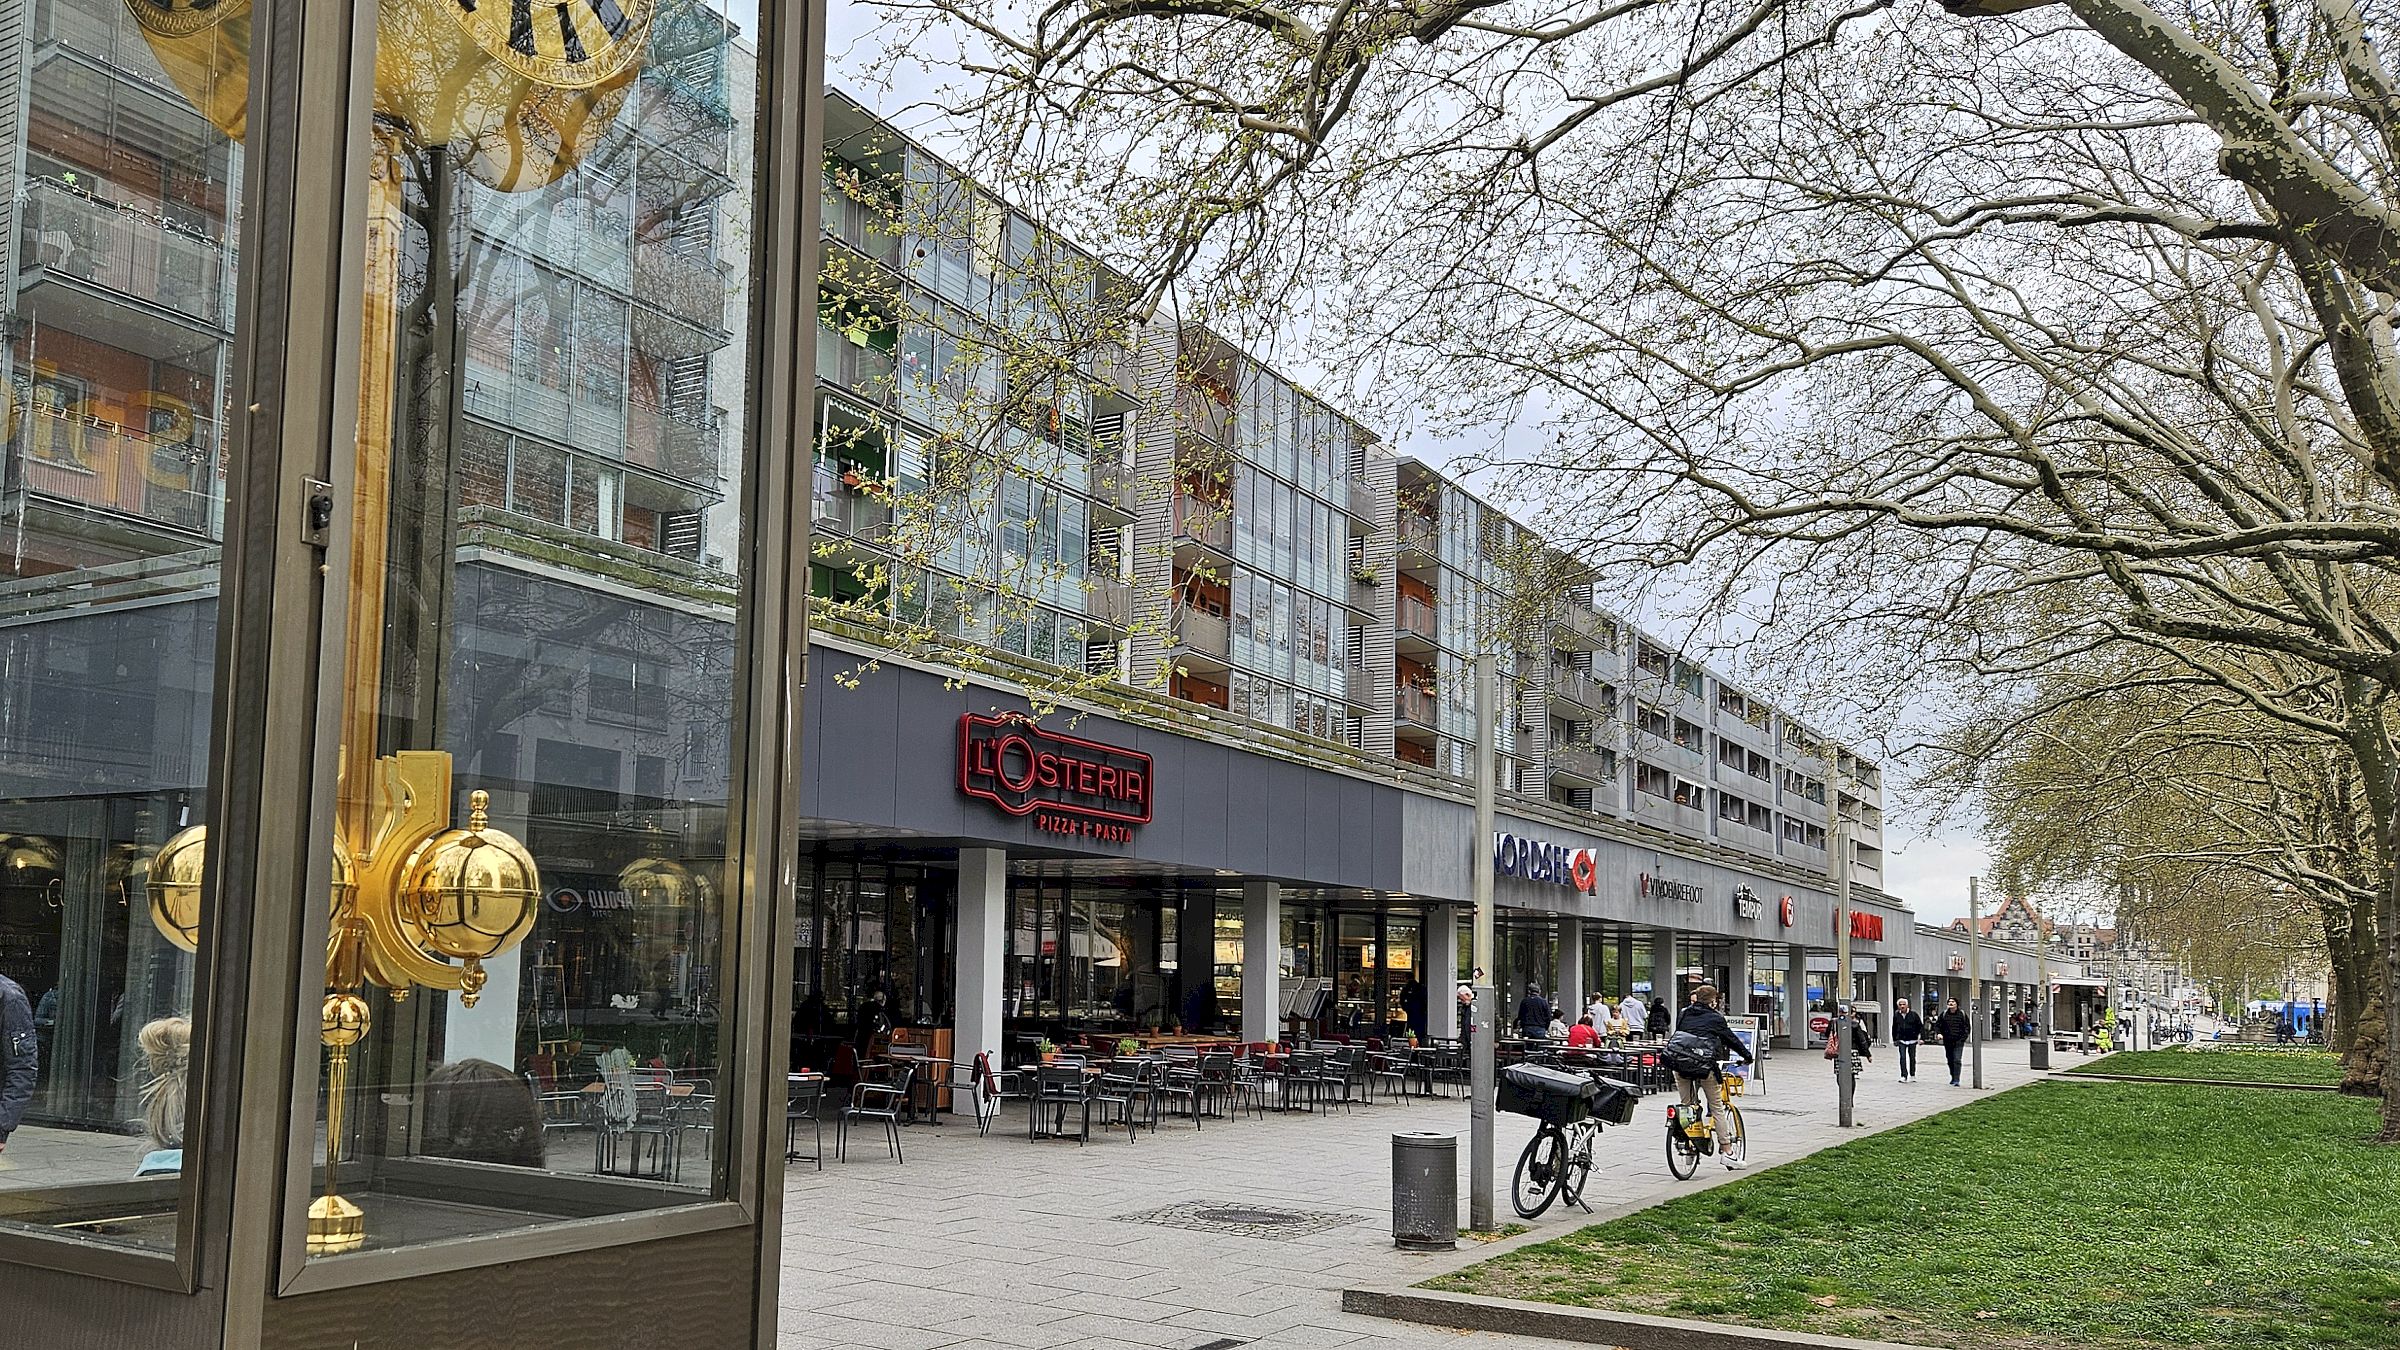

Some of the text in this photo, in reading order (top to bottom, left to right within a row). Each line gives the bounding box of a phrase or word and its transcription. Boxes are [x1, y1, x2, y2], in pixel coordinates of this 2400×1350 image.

[971, 733, 1144, 803] L'OSTERIA
[1037, 813, 1132, 844] PIZZA E PASTA
[1649, 876, 1704, 904] VIVOBAREFOOT
[1738, 898, 1763, 921] TEMPUR
